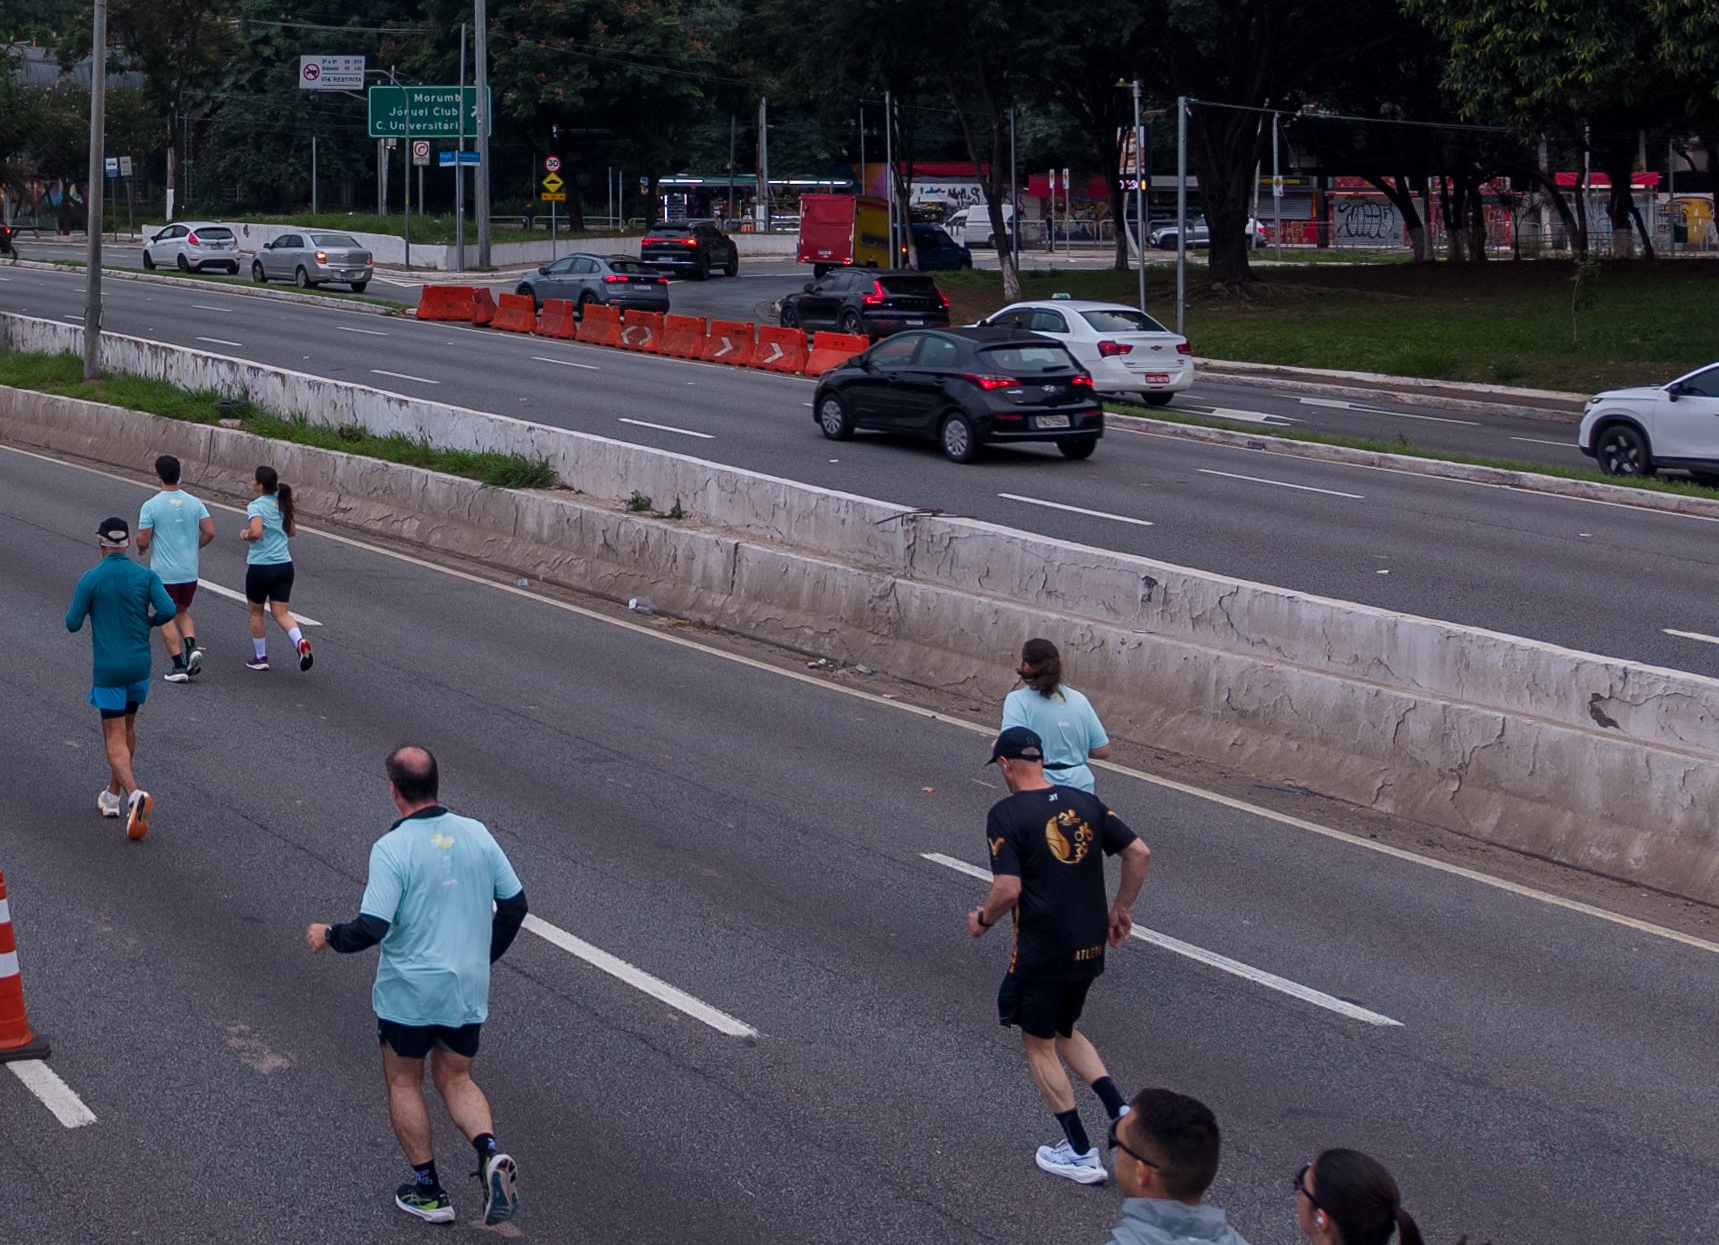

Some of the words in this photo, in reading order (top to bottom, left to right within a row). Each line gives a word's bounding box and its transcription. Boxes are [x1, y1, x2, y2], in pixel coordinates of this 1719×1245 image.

[414, 93, 462, 103] Morumb
[389, 105, 428, 117] Jóuei
[432, 107, 460, 116] Club
[376, 122, 386, 131] C.
[389, 119, 461, 131] Unversitári
[548, 159, 559, 167] 30
